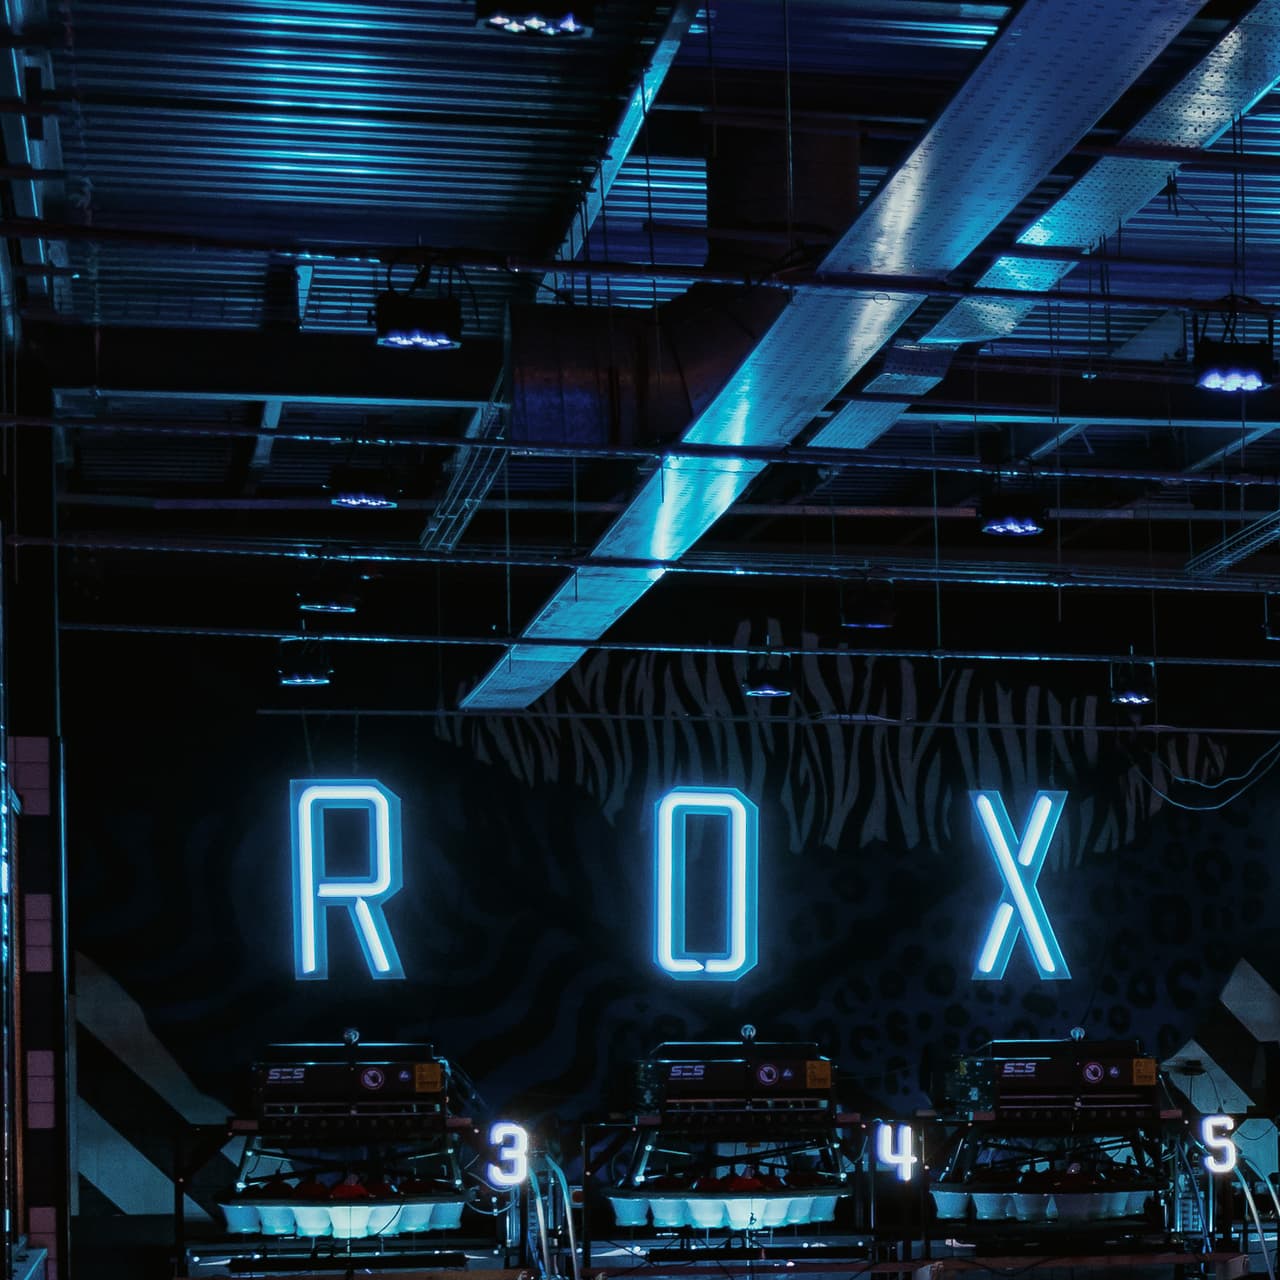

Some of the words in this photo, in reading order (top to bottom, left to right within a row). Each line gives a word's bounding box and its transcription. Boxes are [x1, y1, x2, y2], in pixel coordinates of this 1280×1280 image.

[487, 1121, 528, 1188] 3
[877, 1122, 918, 1182] 4
[1202, 1115, 1237, 1173] 5
